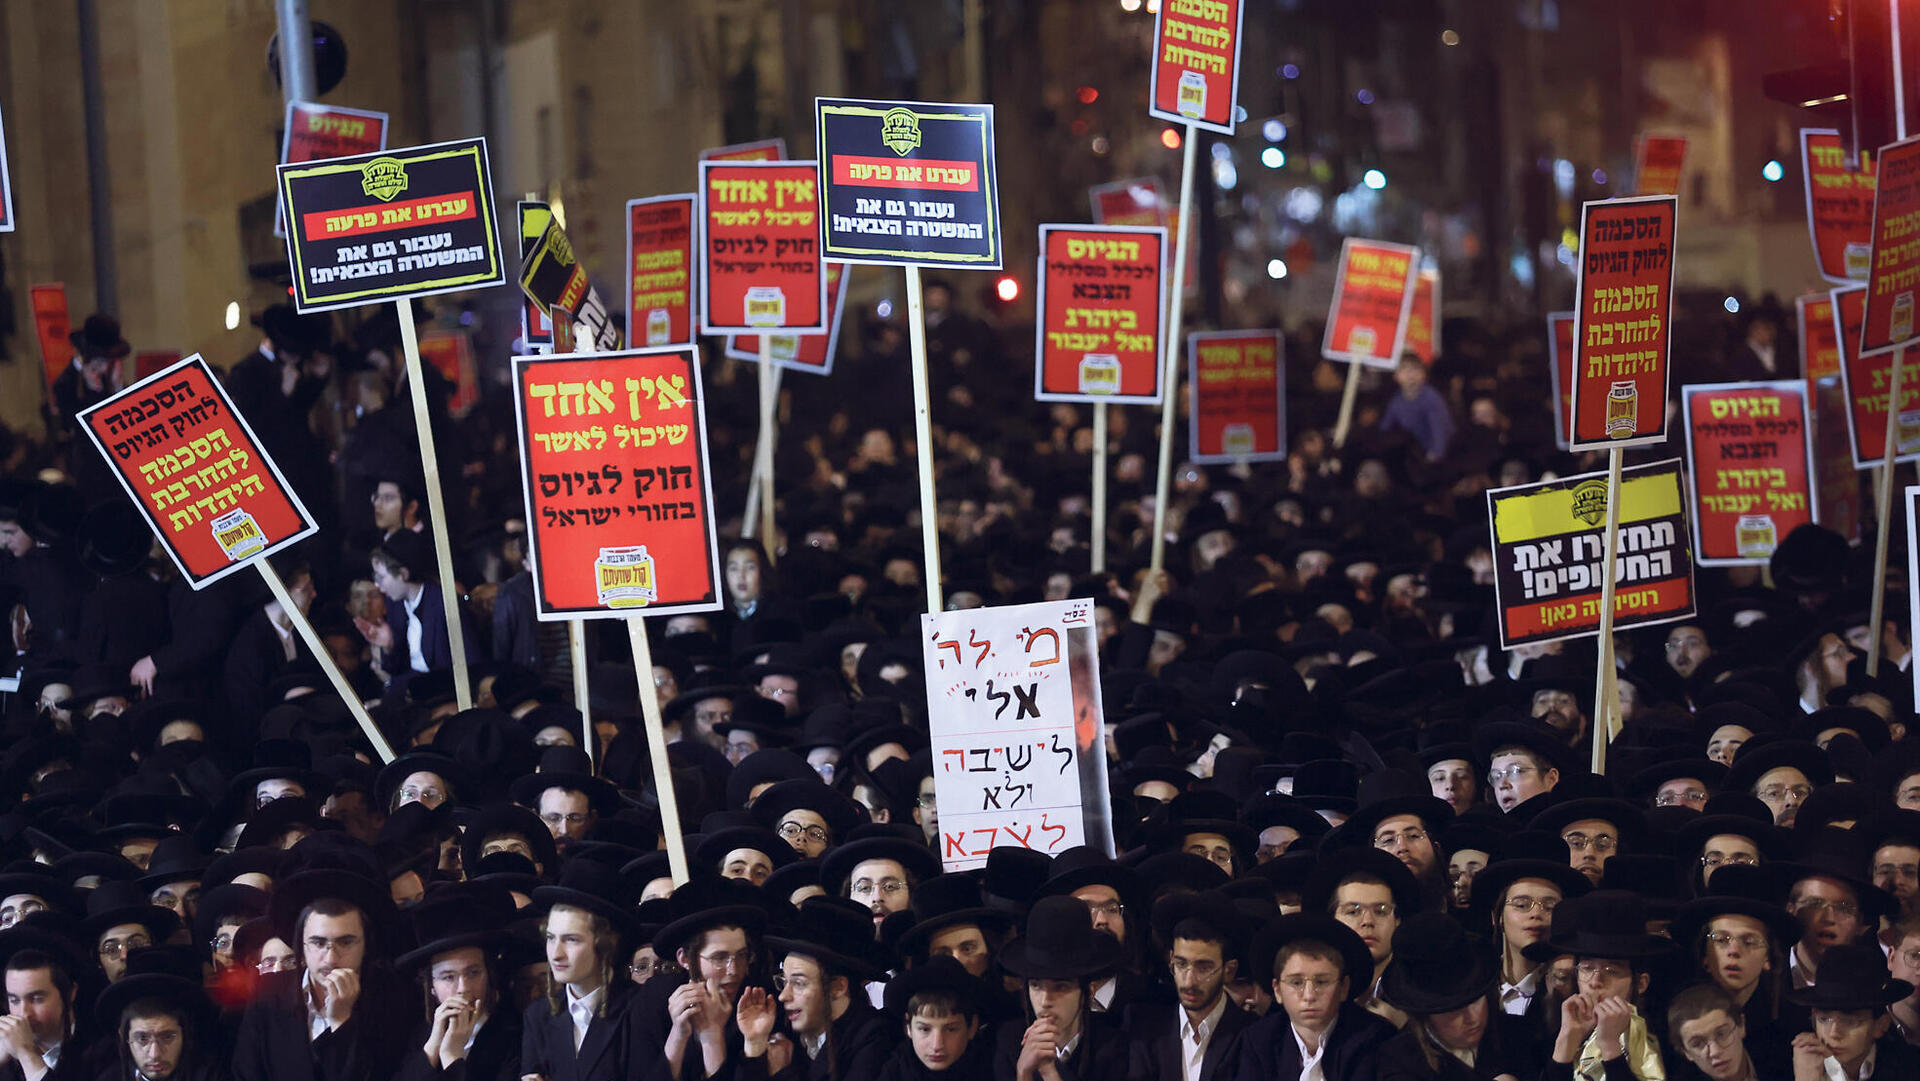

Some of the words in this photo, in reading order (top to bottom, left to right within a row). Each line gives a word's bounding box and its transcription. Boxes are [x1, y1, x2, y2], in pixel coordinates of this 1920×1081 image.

[1165, 18, 1230, 50] להחרבת
[1164, 43, 1227, 75] היהדות
[849, 163, 892, 181] פרעה
[896, 165, 923, 182] את
[926, 166, 971, 185] עברנו
[710, 178, 768, 203] אחד
[774, 178, 815, 208] אין
[382, 206, 412, 225] את
[416, 198, 468, 220] עברנו
[855, 198, 882, 215] את
[885, 200, 907, 216] גם
[909, 200, 955, 218] נעבור
[326, 211, 378, 233] פרעה
[711, 210, 761, 226] לאשר
[764, 210, 815, 226] שיכול
[833, 214, 902, 236] הצבאית!
[906, 219, 984, 239] המשטרה
[1594, 216, 1661, 243] הסכמה
[372, 240, 398, 258] גם
[401, 232, 453, 251] נעבור
[713, 235, 768, 254] לגיוס
[775, 237, 814, 257] חוק
[1067, 239, 1140, 260] הגיוס
[337, 245, 368, 263] את
[398, 245, 485, 272] המשטרה
[1588, 250, 1629, 276] הגיוס
[1632, 243, 1667, 277] לחוק
[309, 259, 394, 284] הצבאית!
[1073, 283, 1131, 300] הצבא
[1593, 284, 1659, 315] הסכמה
[1065, 307, 1137, 328] ביהרג
[1048, 331, 1109, 351] יעבור
[1113, 331, 1153, 352] ואל
[1587, 314, 1661, 347] להחרבת
[1587, 350, 1658, 378] היהדות
[104, 380, 195, 435] הסכמה
[530, 378, 616, 418] אחד
[625, 374, 687, 421] אין
[1709, 397, 1780, 419] הגיוס
[169, 396, 218, 438] לחוק
[113, 423, 170, 460] הגיוס
[534, 426, 608, 453] לאשר
[613, 424, 689, 448] שיכול
[139, 428, 232, 485] הסכמה
[1720, 442, 1778, 460] הצבא
[151, 448, 250, 511] להחרבת
[539, 464, 622, 498] לגיוס
[633, 465, 693, 499] חוק
[1716, 468, 1787, 489] ביהרג
[168, 473, 265, 532] היהדות
[628, 501, 696, 522] בחורי
[1702, 494, 1761, 513] יעבור
[1766, 490, 1806, 511] ואל
[542, 506, 620, 528] ישראל
[1513, 539, 1563, 572] את
[1540, 605, 1577, 627] כאן!
[965, 679, 1041, 720] אלי
[942, 734, 1073, 775] לישיבה
[982, 775, 1033, 811] ולא
